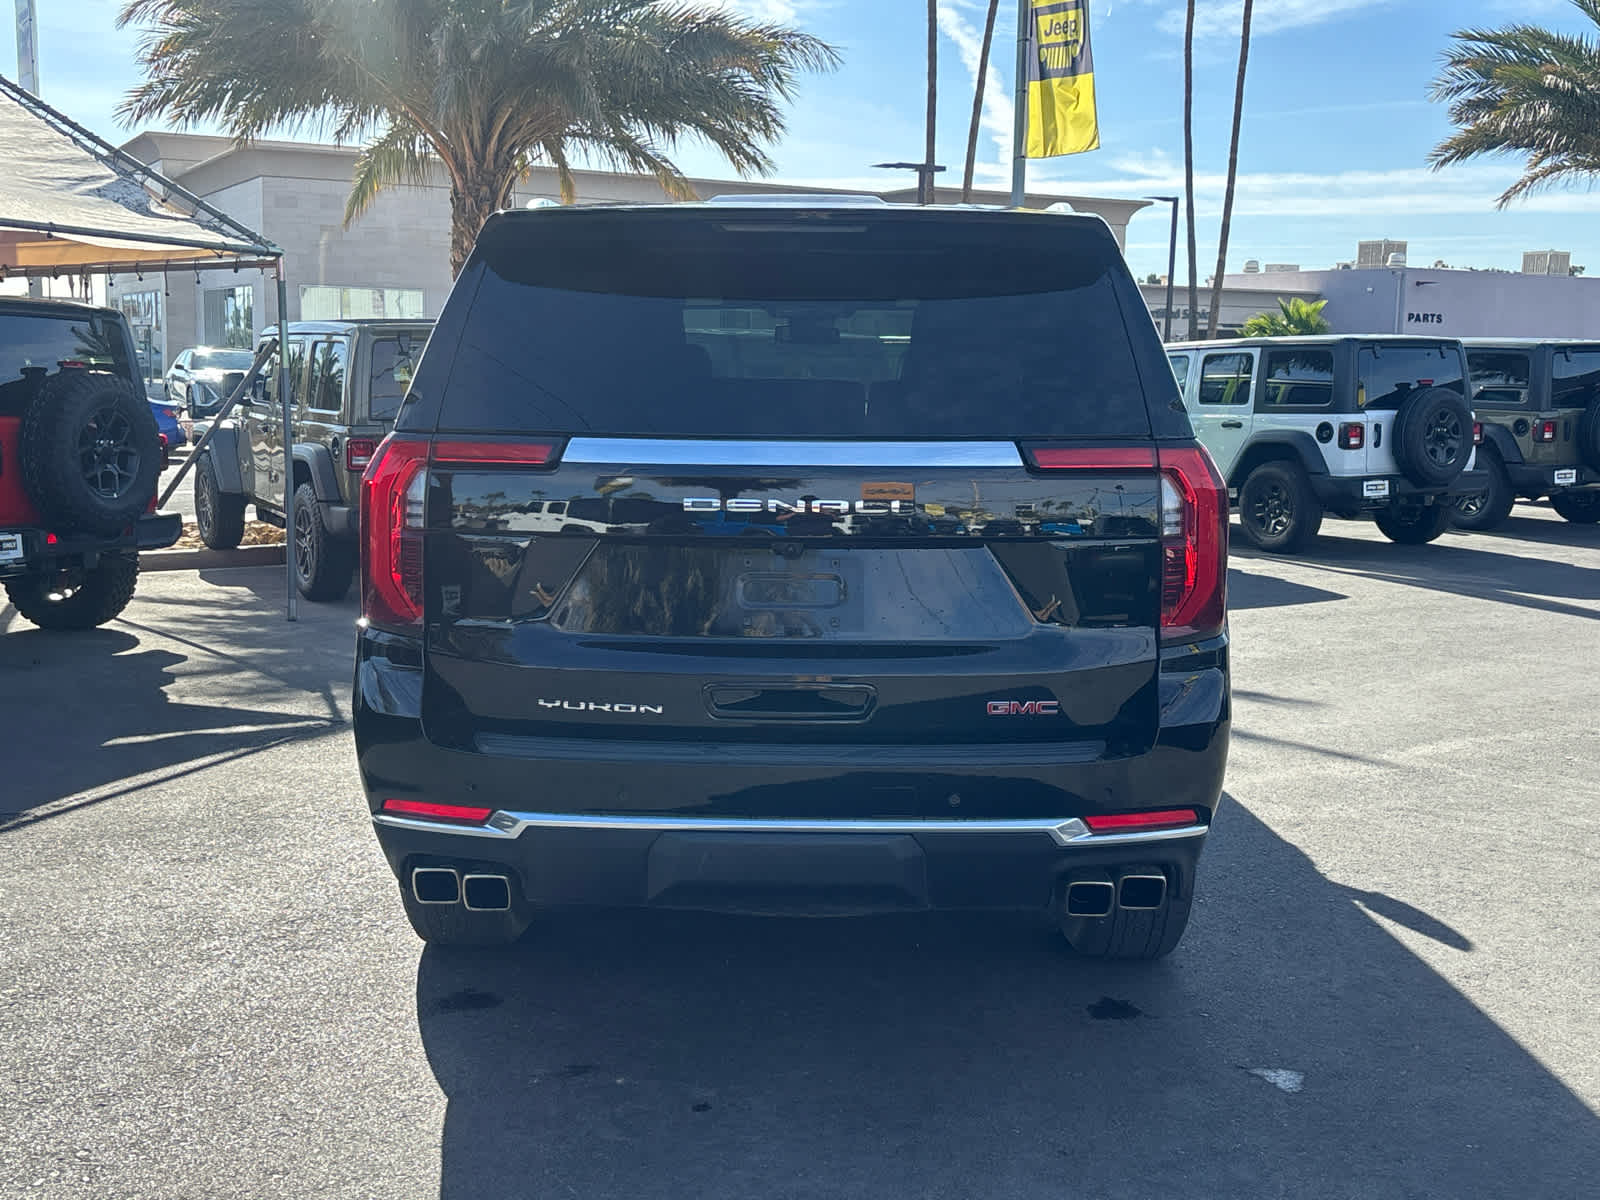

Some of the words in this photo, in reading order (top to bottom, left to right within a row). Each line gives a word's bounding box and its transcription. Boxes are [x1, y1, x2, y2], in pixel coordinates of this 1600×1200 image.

[1044, 19, 1077, 37] Jeep
[1408, 313, 1443, 323] PARTS
[683, 498, 901, 513] DENALI
[538, 699, 663, 713] YUKON
[987, 701, 1058, 714] GMC
